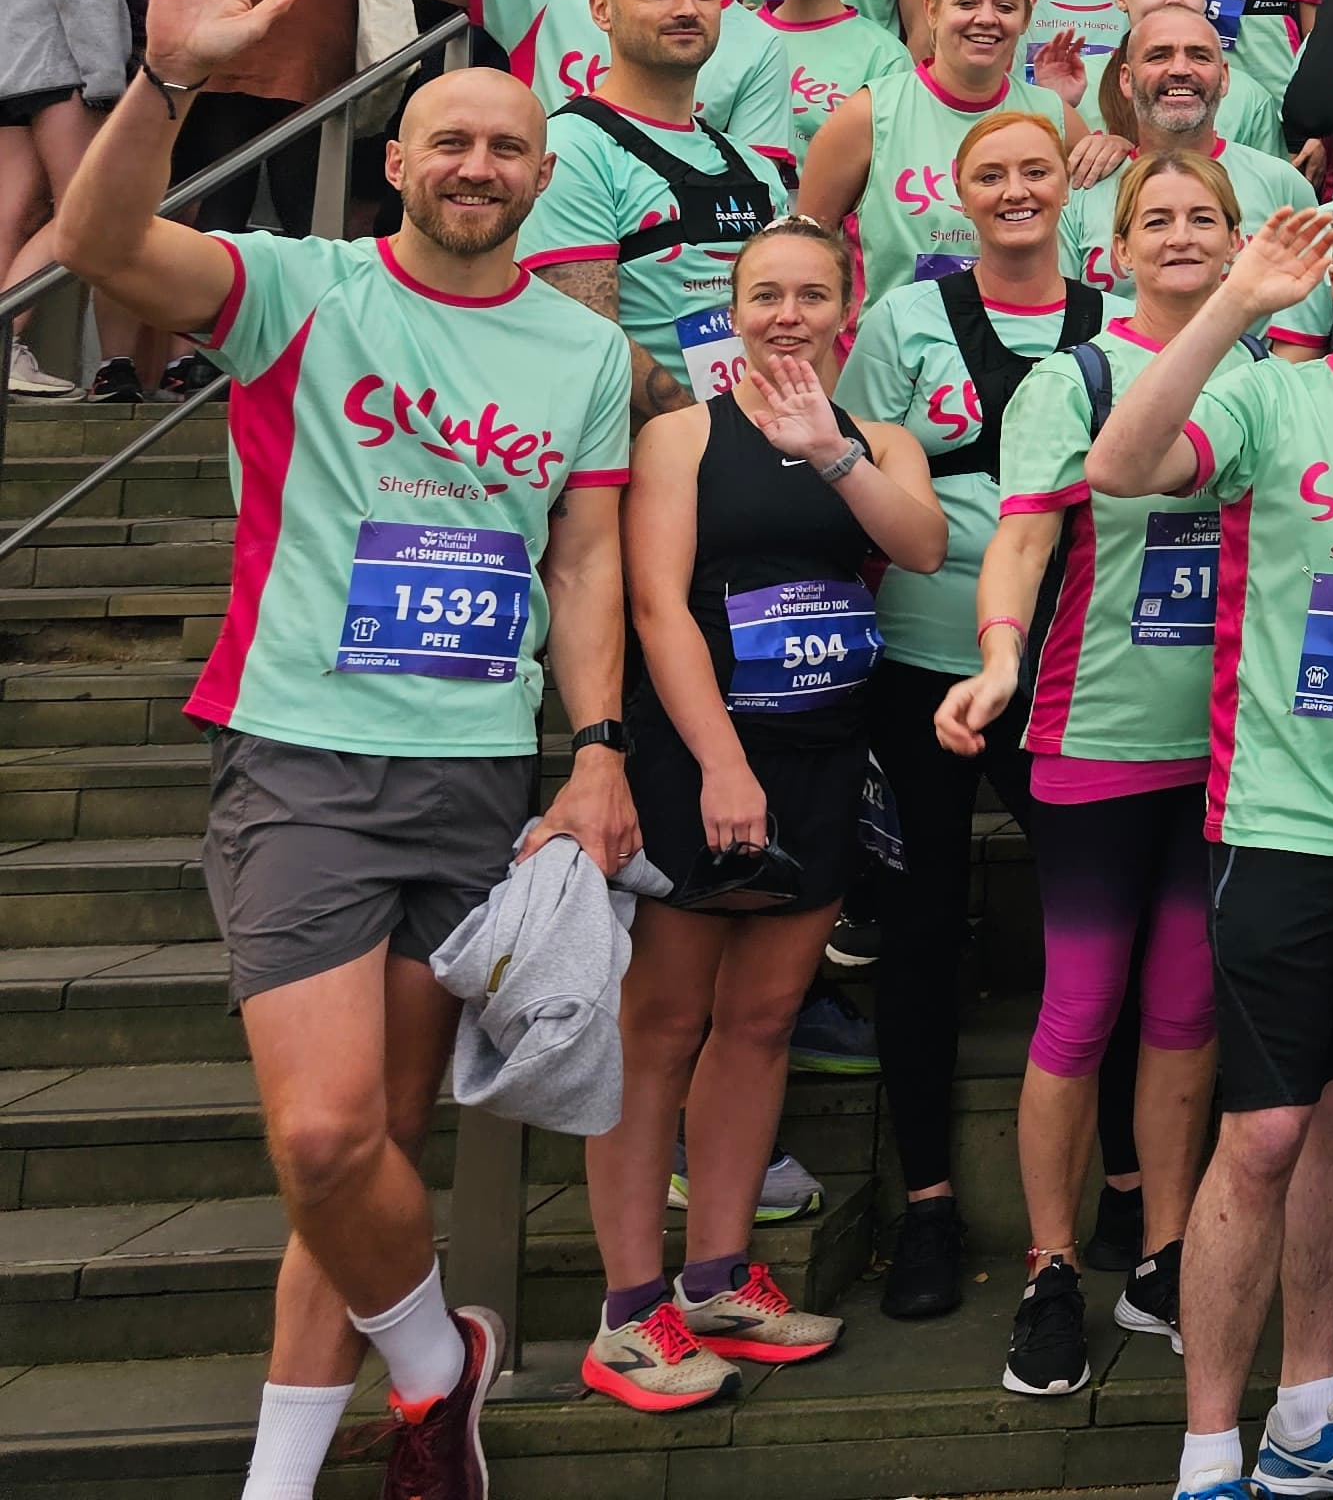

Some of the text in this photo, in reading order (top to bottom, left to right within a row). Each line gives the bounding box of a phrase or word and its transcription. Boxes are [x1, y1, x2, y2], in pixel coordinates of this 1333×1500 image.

[1035, 19, 1119, 32] Sheffield's Hospice
[790, 66, 849, 113] ke's
[894, 165, 947, 216] St
[710, 356, 748, 394] 30
[378, 475, 479, 501] Sheffield's
[438, 530, 477, 543] Sheffield
[438, 539, 471, 550] Mutual
[1191, 531, 1221, 543] SHEFF
[417, 549, 505, 566] SHEFFIELD 10K
[395, 584, 498, 627] 1532
[782, 600, 850, 614] SHEFFIELD 10K
[421, 632, 461, 648] PETE
[782, 633, 849, 669] 504
[366, 658, 385, 666] FOR
[385, 658, 401, 667] ALL
[792, 672, 832, 688] LYDIA
